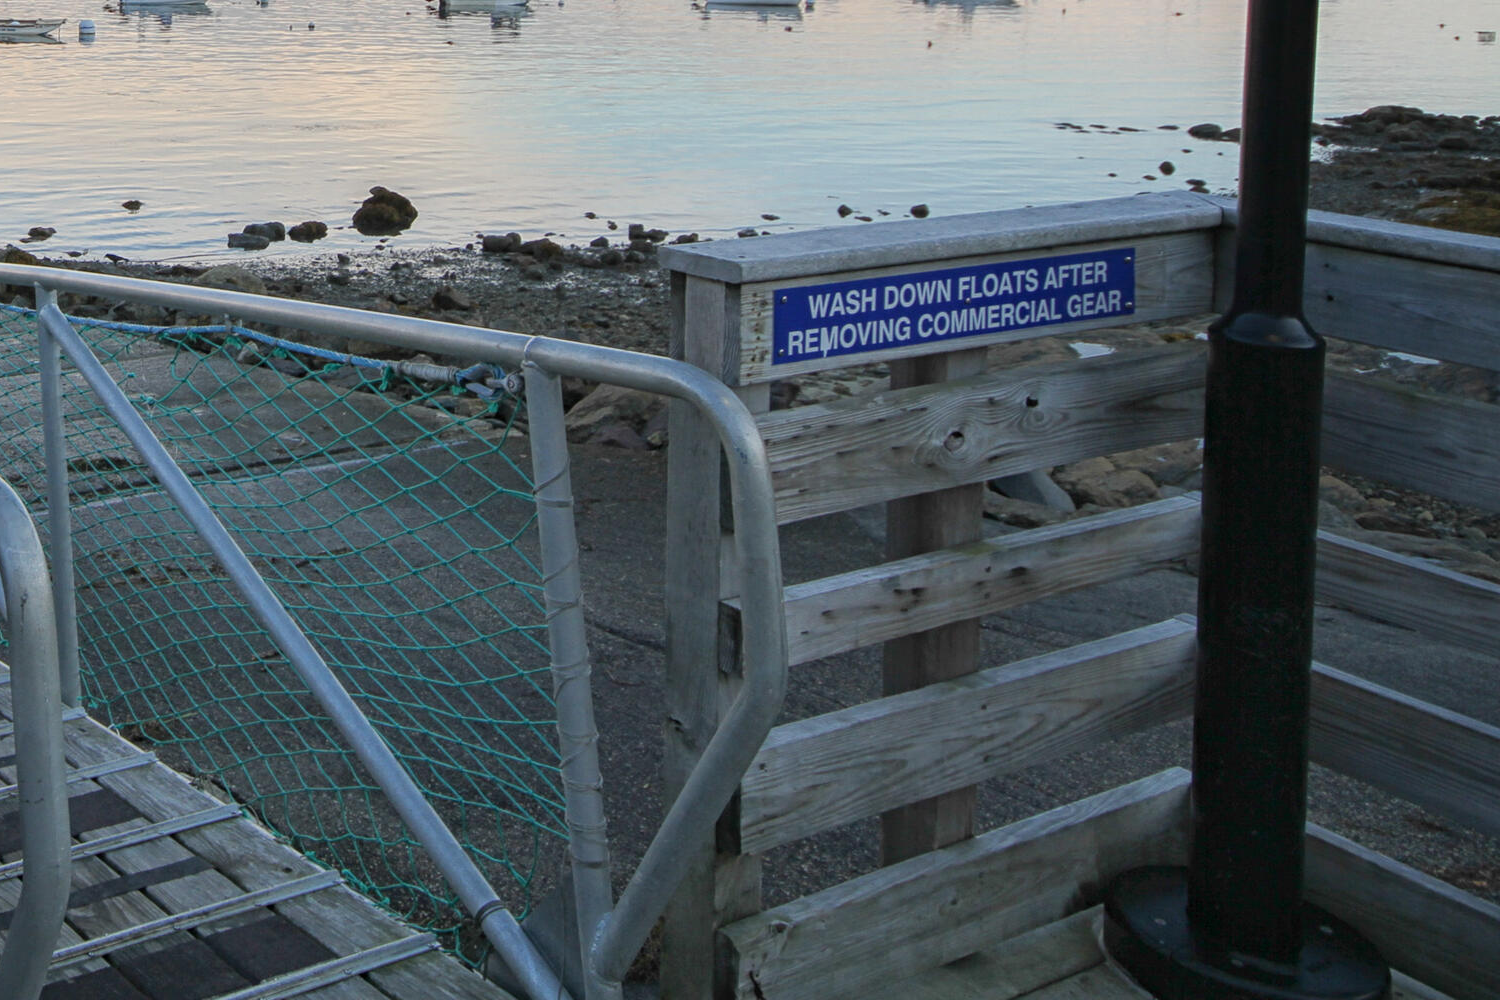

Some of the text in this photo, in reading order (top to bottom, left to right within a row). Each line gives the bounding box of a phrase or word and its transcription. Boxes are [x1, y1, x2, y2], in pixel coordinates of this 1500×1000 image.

[808, 261, 1108, 319] WASH DOWN FLOATS AFTER
[788, 290, 1121, 356] REMOVING COMMERCIAL GEAR
